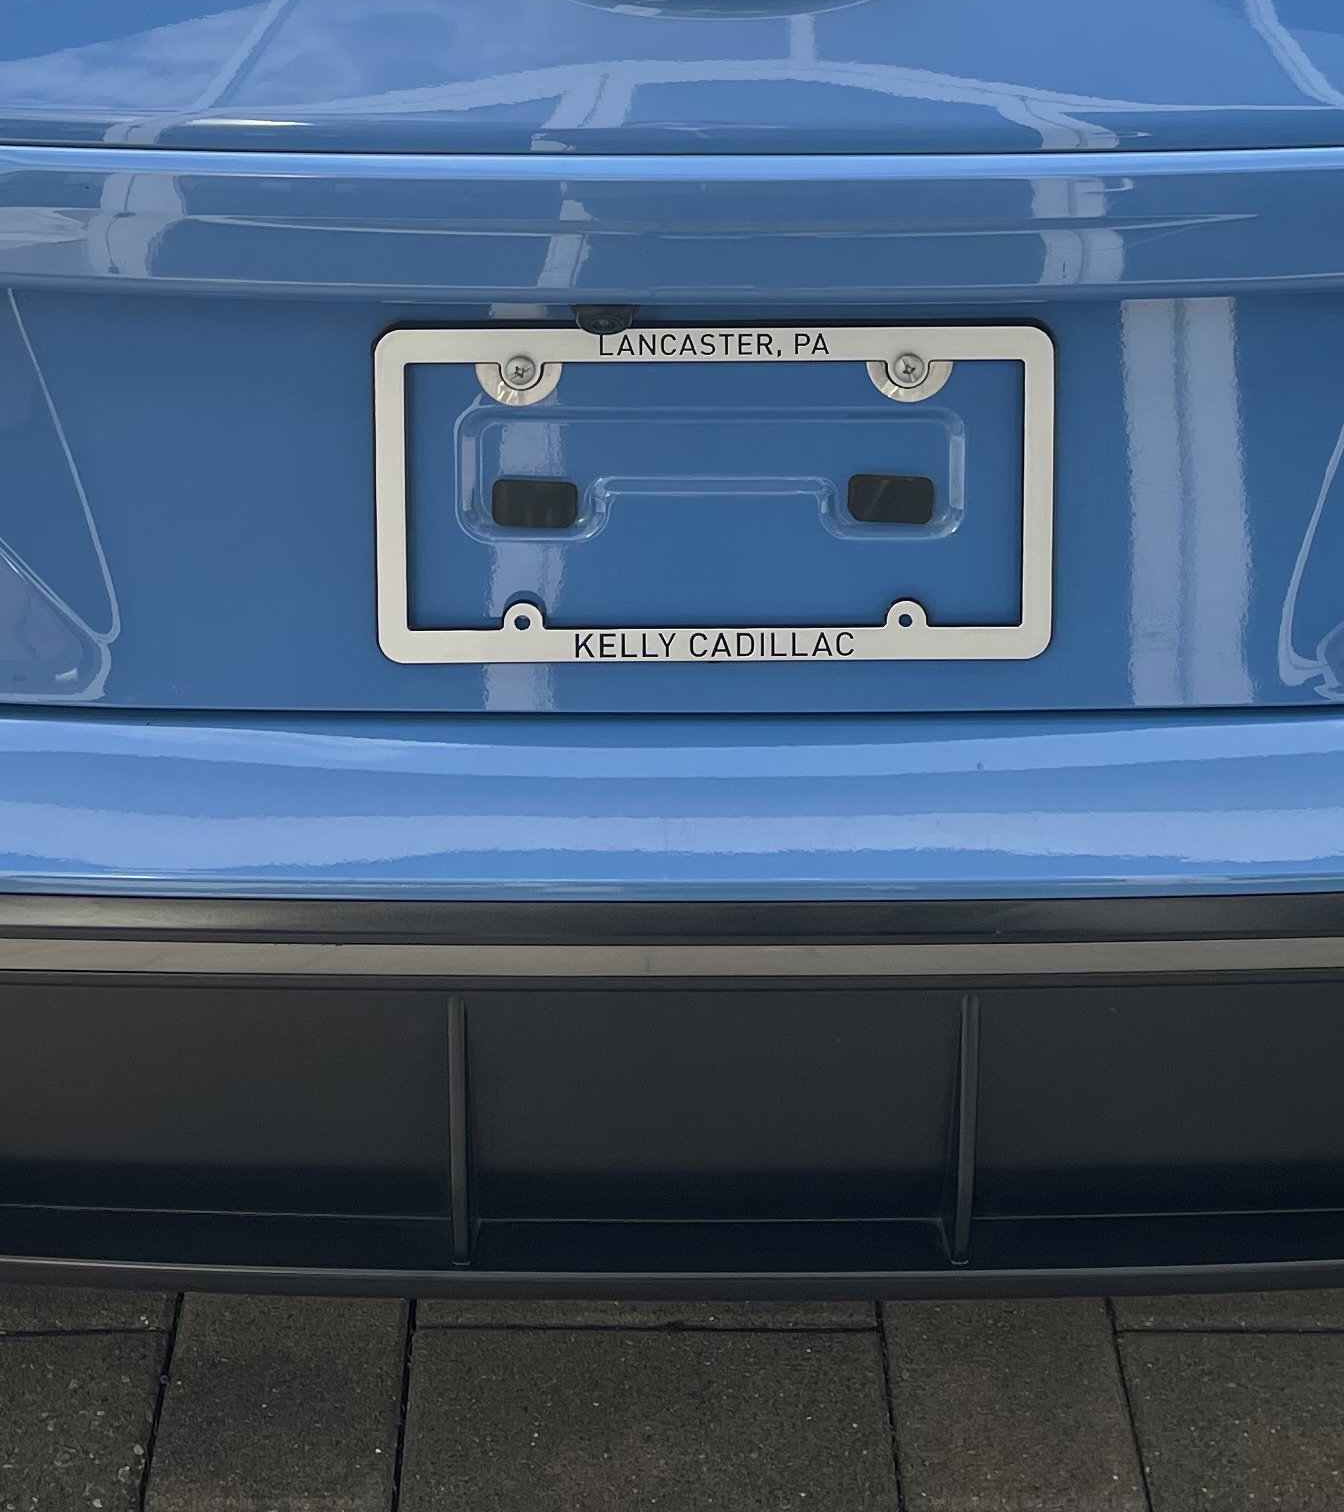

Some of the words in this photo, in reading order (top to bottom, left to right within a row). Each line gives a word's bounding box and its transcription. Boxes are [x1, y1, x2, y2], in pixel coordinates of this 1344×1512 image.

[598, 333, 783, 358] LANCASTER,
[793, 332, 831, 356] PA
[574, 632, 677, 659] KELLY
[688, 631, 856, 658] CADILLAC
